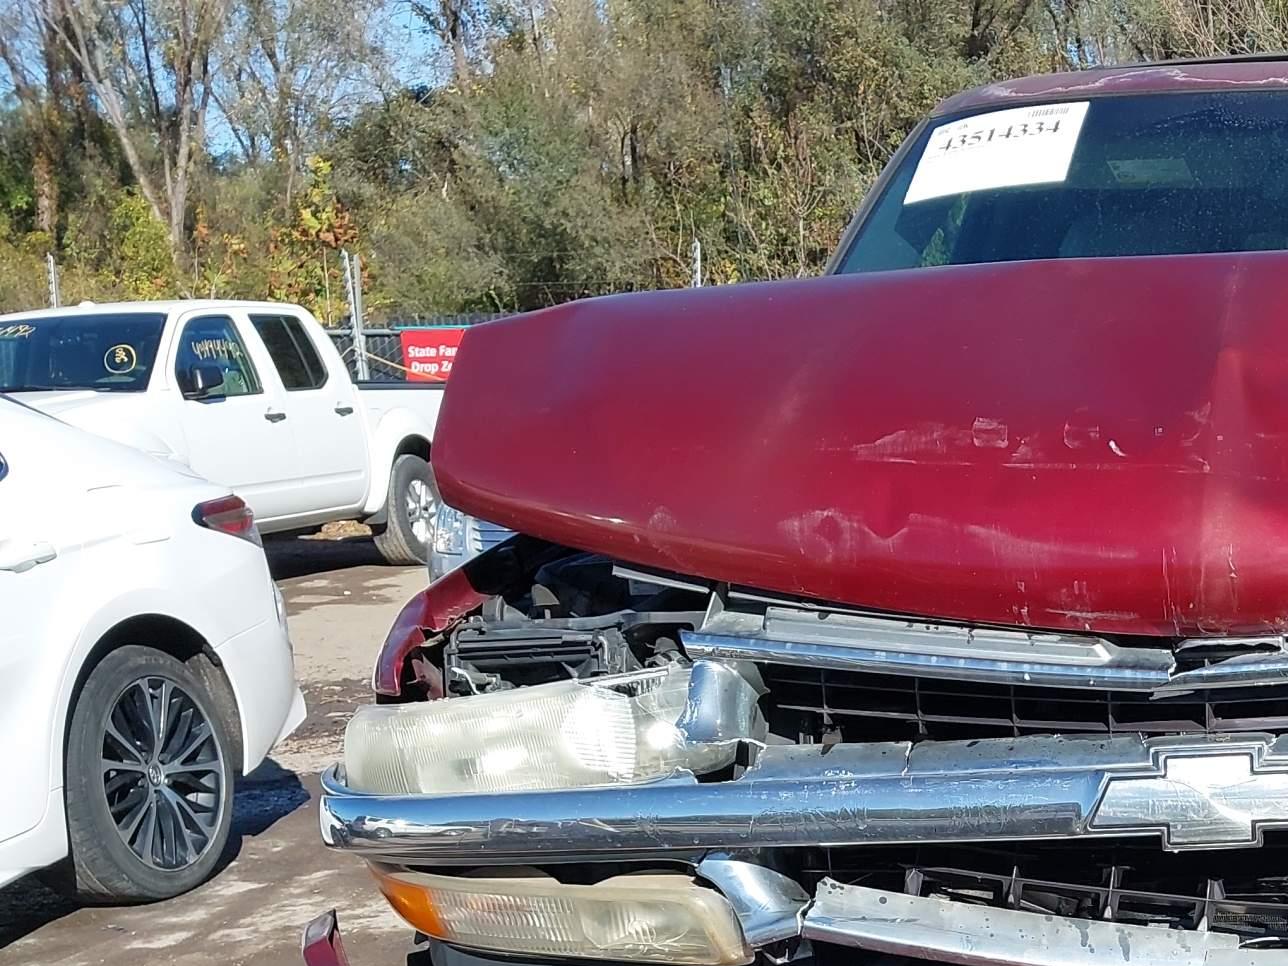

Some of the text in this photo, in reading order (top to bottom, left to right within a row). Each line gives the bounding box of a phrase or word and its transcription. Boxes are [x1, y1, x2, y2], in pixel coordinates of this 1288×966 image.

[938, 119, 1061, 151] 43514334
[407, 344, 459, 358] State Far
[410, 361, 440, 375] Drop
